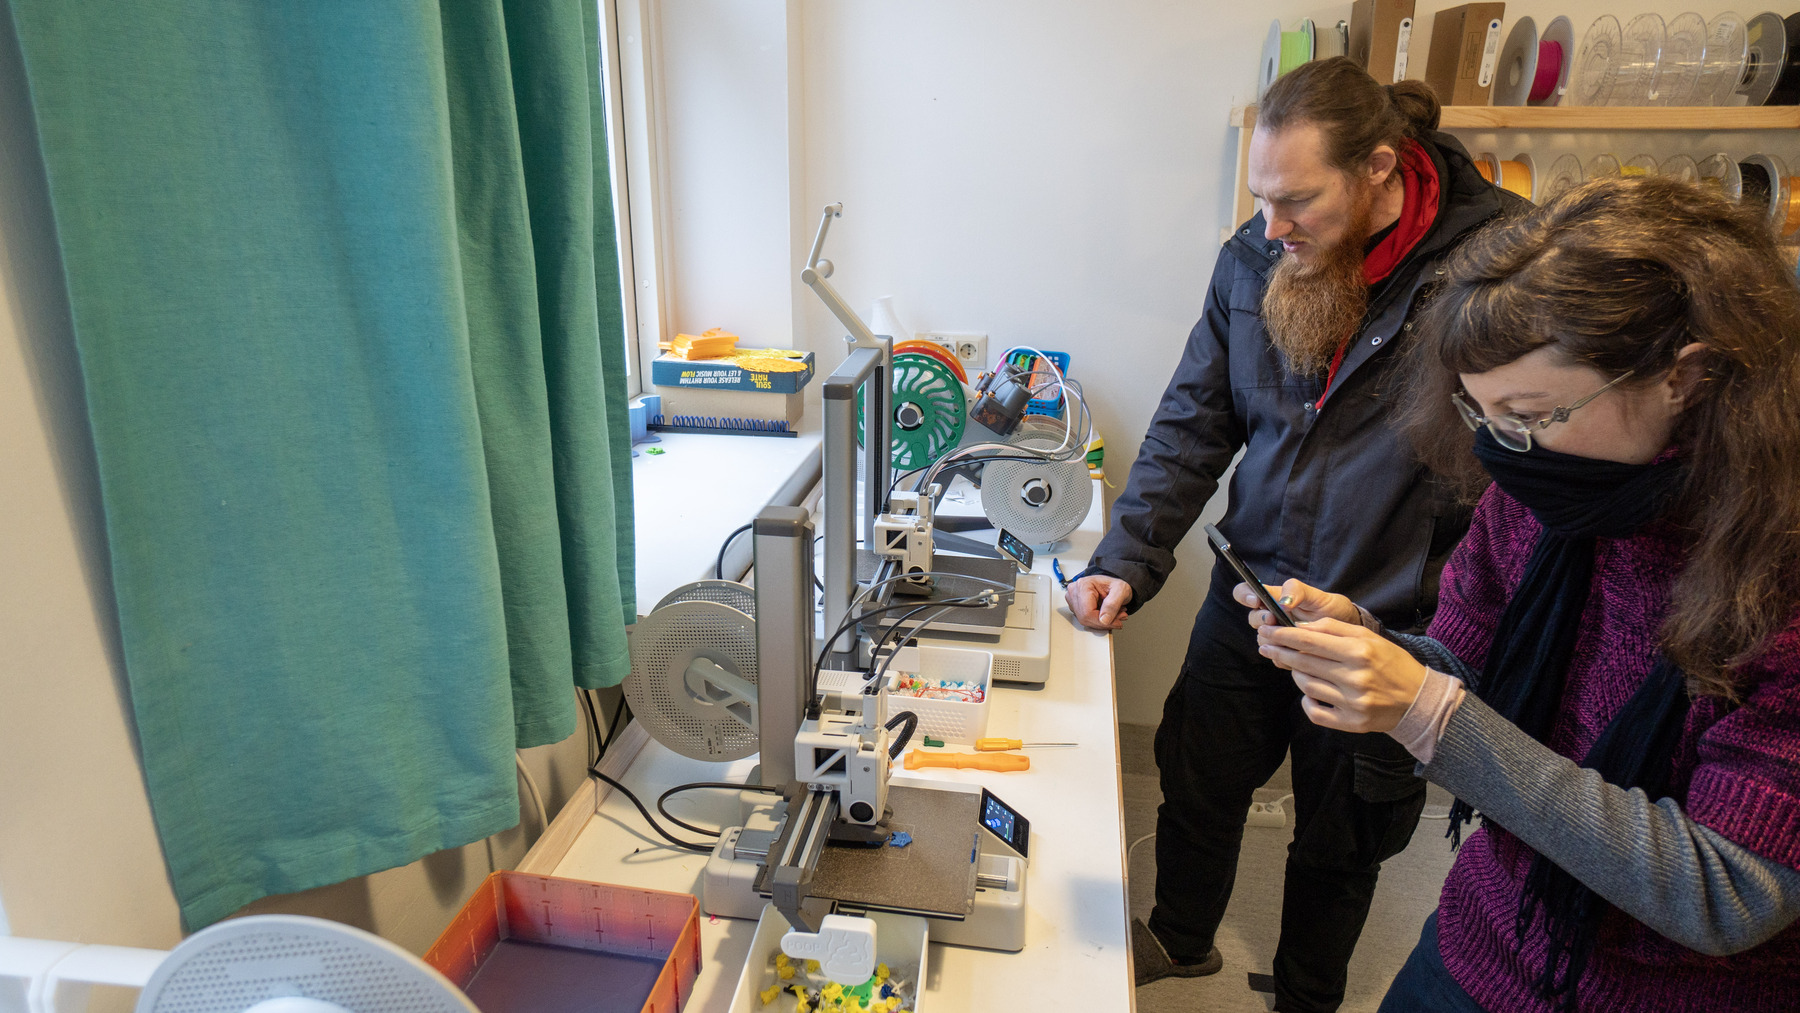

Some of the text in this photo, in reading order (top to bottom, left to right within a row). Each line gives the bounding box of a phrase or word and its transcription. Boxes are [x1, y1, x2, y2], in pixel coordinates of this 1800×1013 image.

[679, 377, 703, 385] RHYTHM
[718, 376, 741, 384] RELEASE
[754, 381, 772, 390] SOUL
[786, 940, 822, 953] POOP
